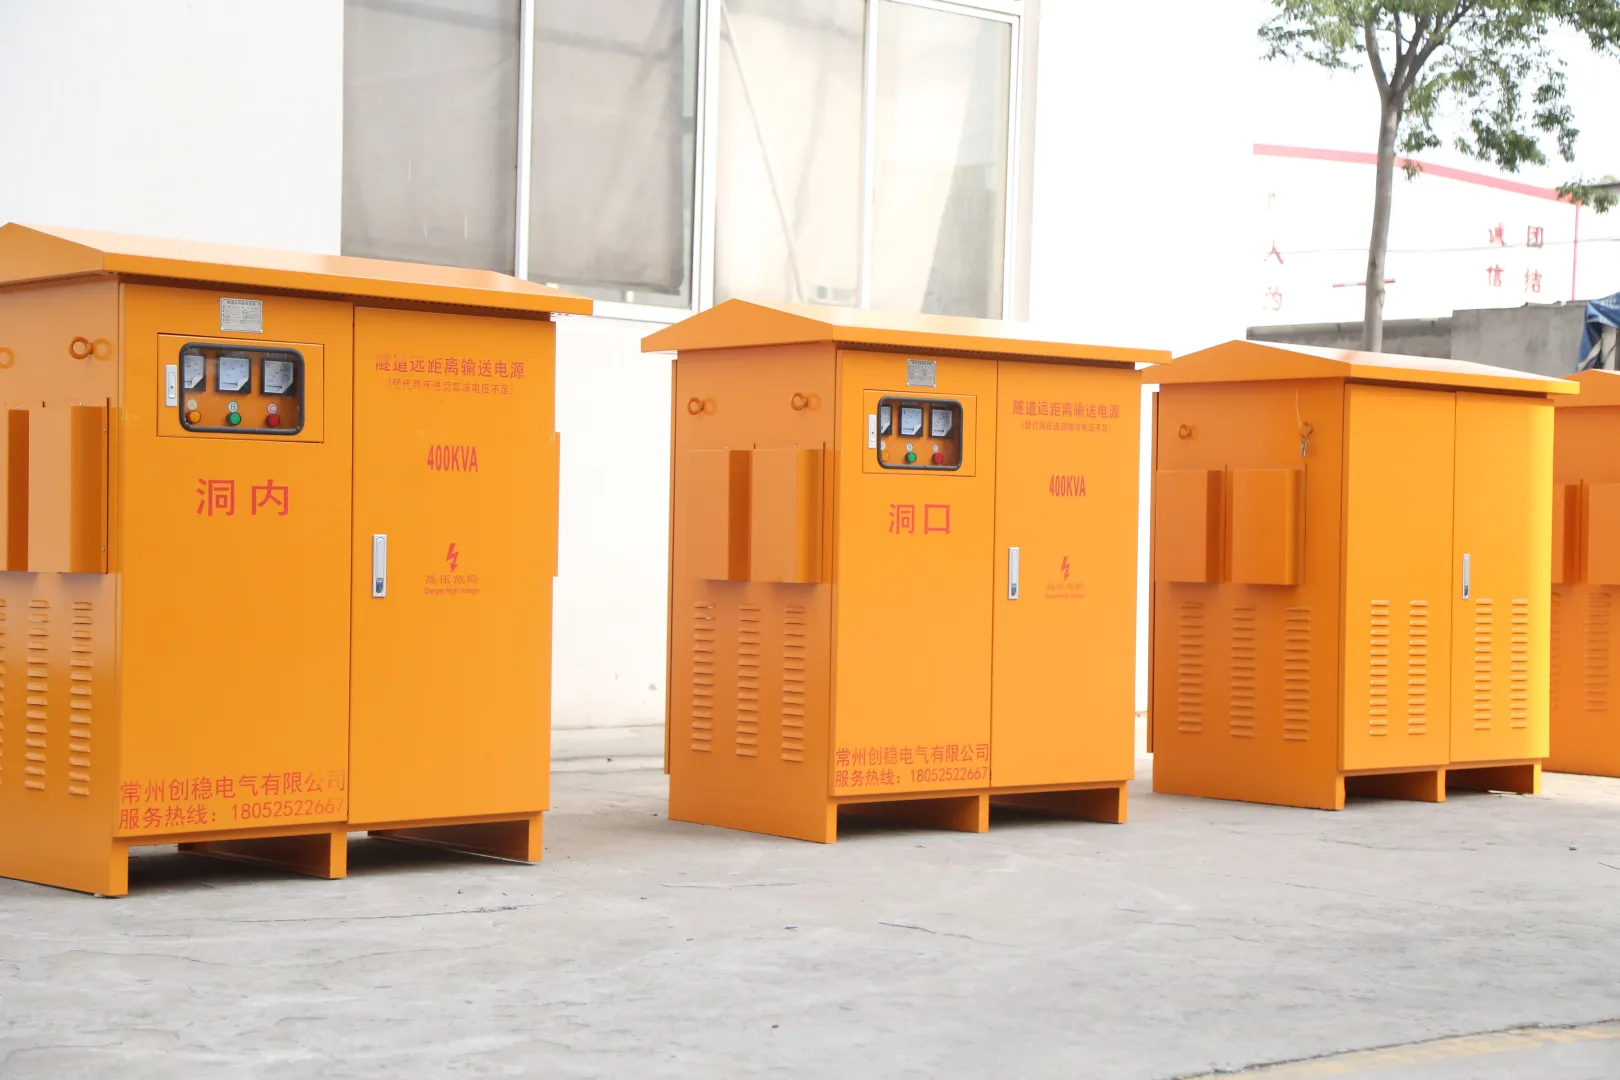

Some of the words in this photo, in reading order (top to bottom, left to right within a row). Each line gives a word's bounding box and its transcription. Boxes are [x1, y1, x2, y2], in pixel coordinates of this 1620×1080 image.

[375, 353, 525, 379] 隧道远距离输送电源
[1012, 400, 1121, 420] 隧道远距离输送电源
[427, 444, 479, 473] 400KVA
[196, 477, 290, 517] 洞内
[1049, 475, 1086, 497] 400KVA
[888, 503, 951, 535] 洞口
[835, 743, 989, 767] 常州创稳电气有限公司
[120, 770, 346, 804] 常州创稳电气有限公司
